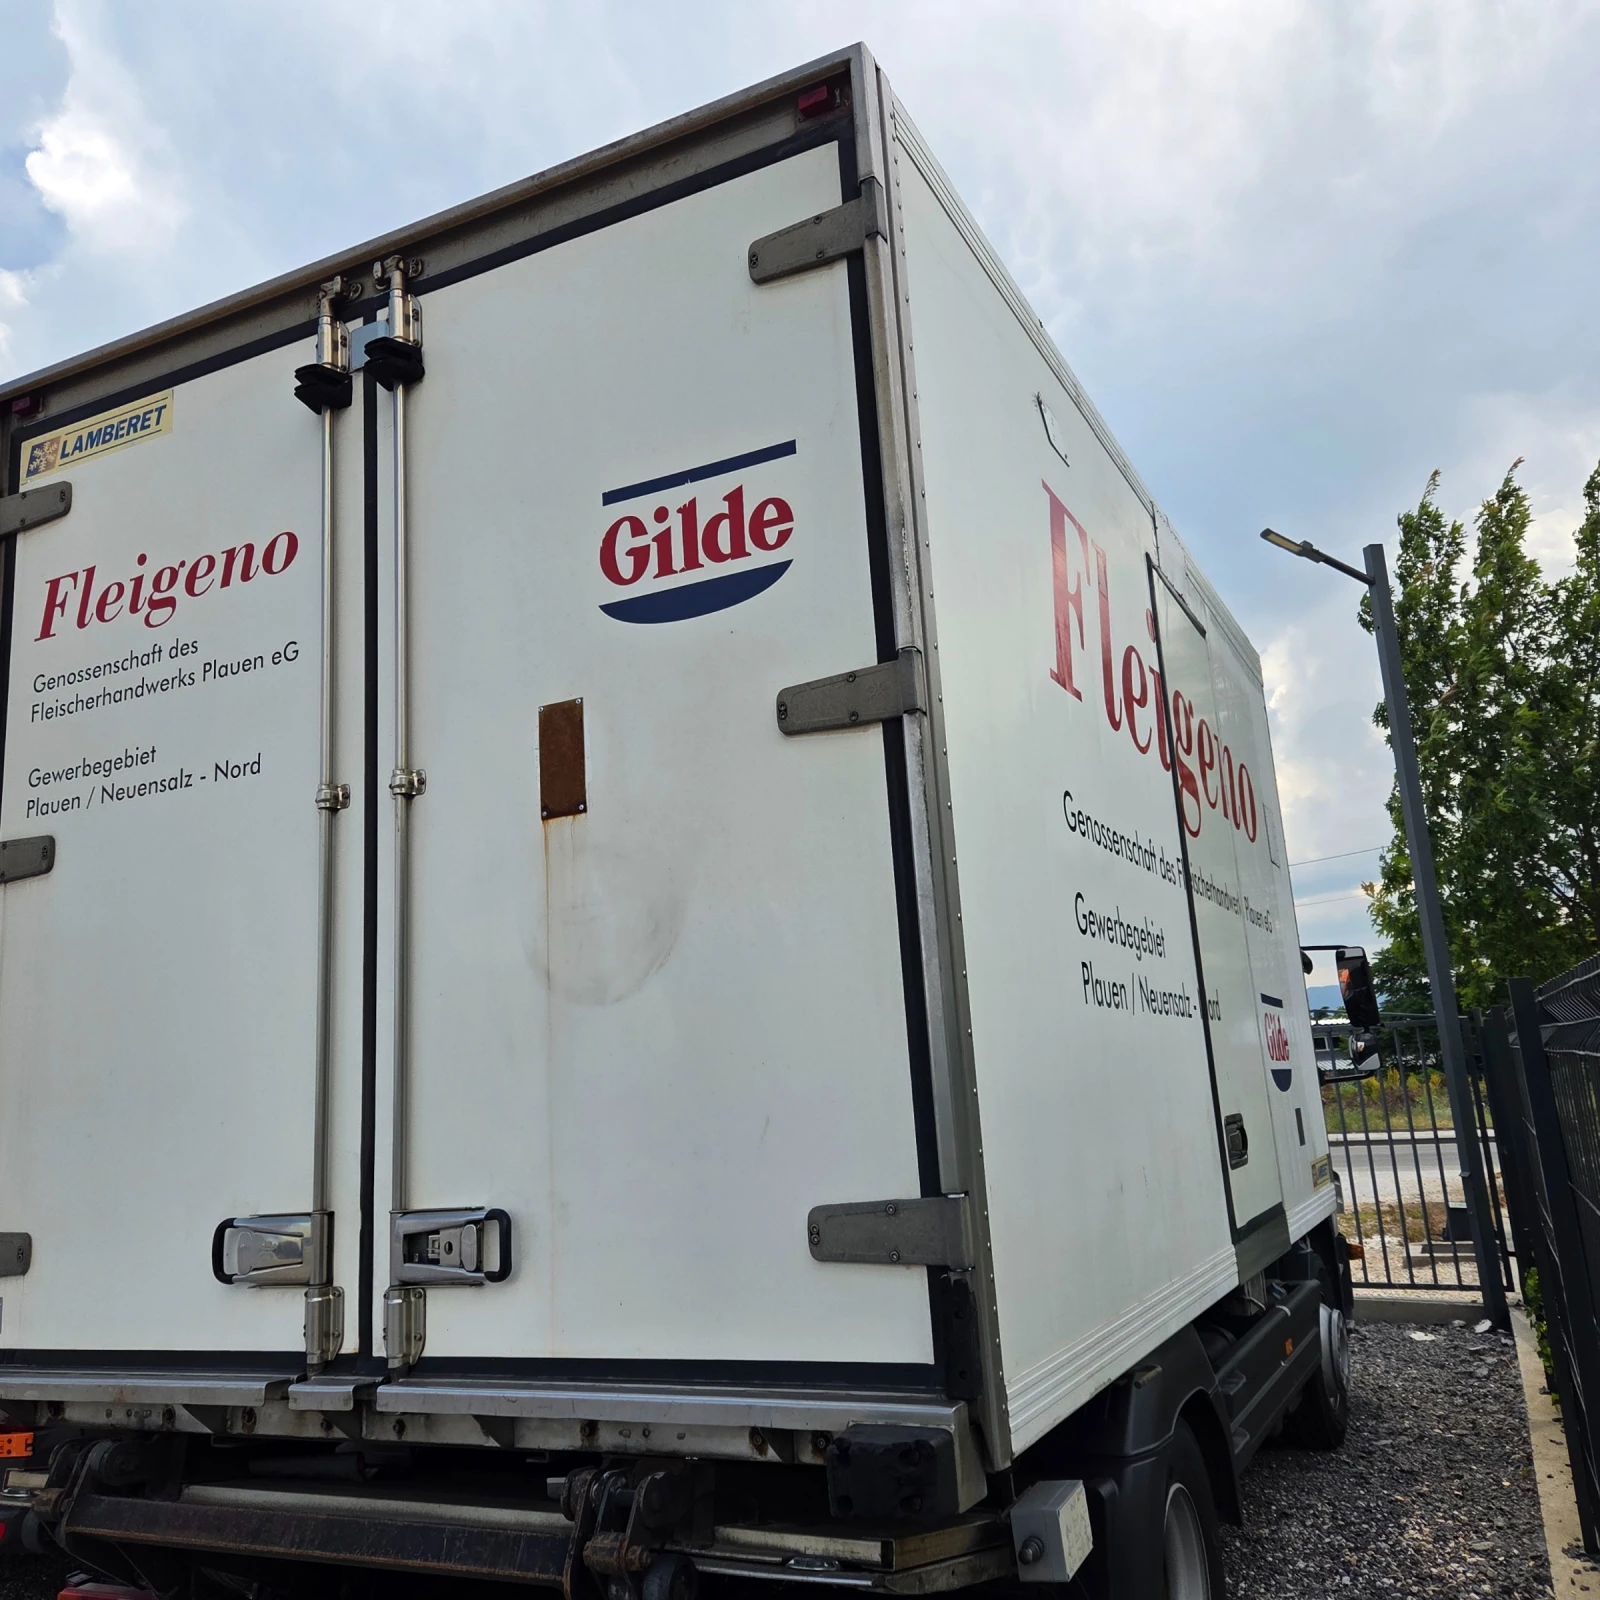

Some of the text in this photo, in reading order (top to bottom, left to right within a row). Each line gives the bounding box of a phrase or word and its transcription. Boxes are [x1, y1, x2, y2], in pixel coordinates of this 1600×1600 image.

[59, 404, 168, 460] LAMBERET
[599, 484, 794, 586] Gilde
[34, 531, 299, 642] Fleigeno
[31, 641, 300, 723] Fleischerhandwerks Plauen eG
[33, 638, 199, 693] Genossenschaft des
[1041, 478, 1257, 843] Fleigeno
[26, 795, 81, 819] Plauen
[86, 786, 96, 810] /
[101, 768, 193, 804] Neuensalz
[214, 753, 262, 783] Nord
[28, 746, 156, 788] Gewerbegebiet
[1063, 790, 1158, 876] Genossenschaft
[1160, 845, 1177, 886] des
[1075, 891, 1166, 962] Gewerbegebiet
[1081, 960, 1128, 1010] Plauen
[1138, 975, 1193, 1018] Neuensalz
[1264, 1012, 1290, 1062] Gilde
